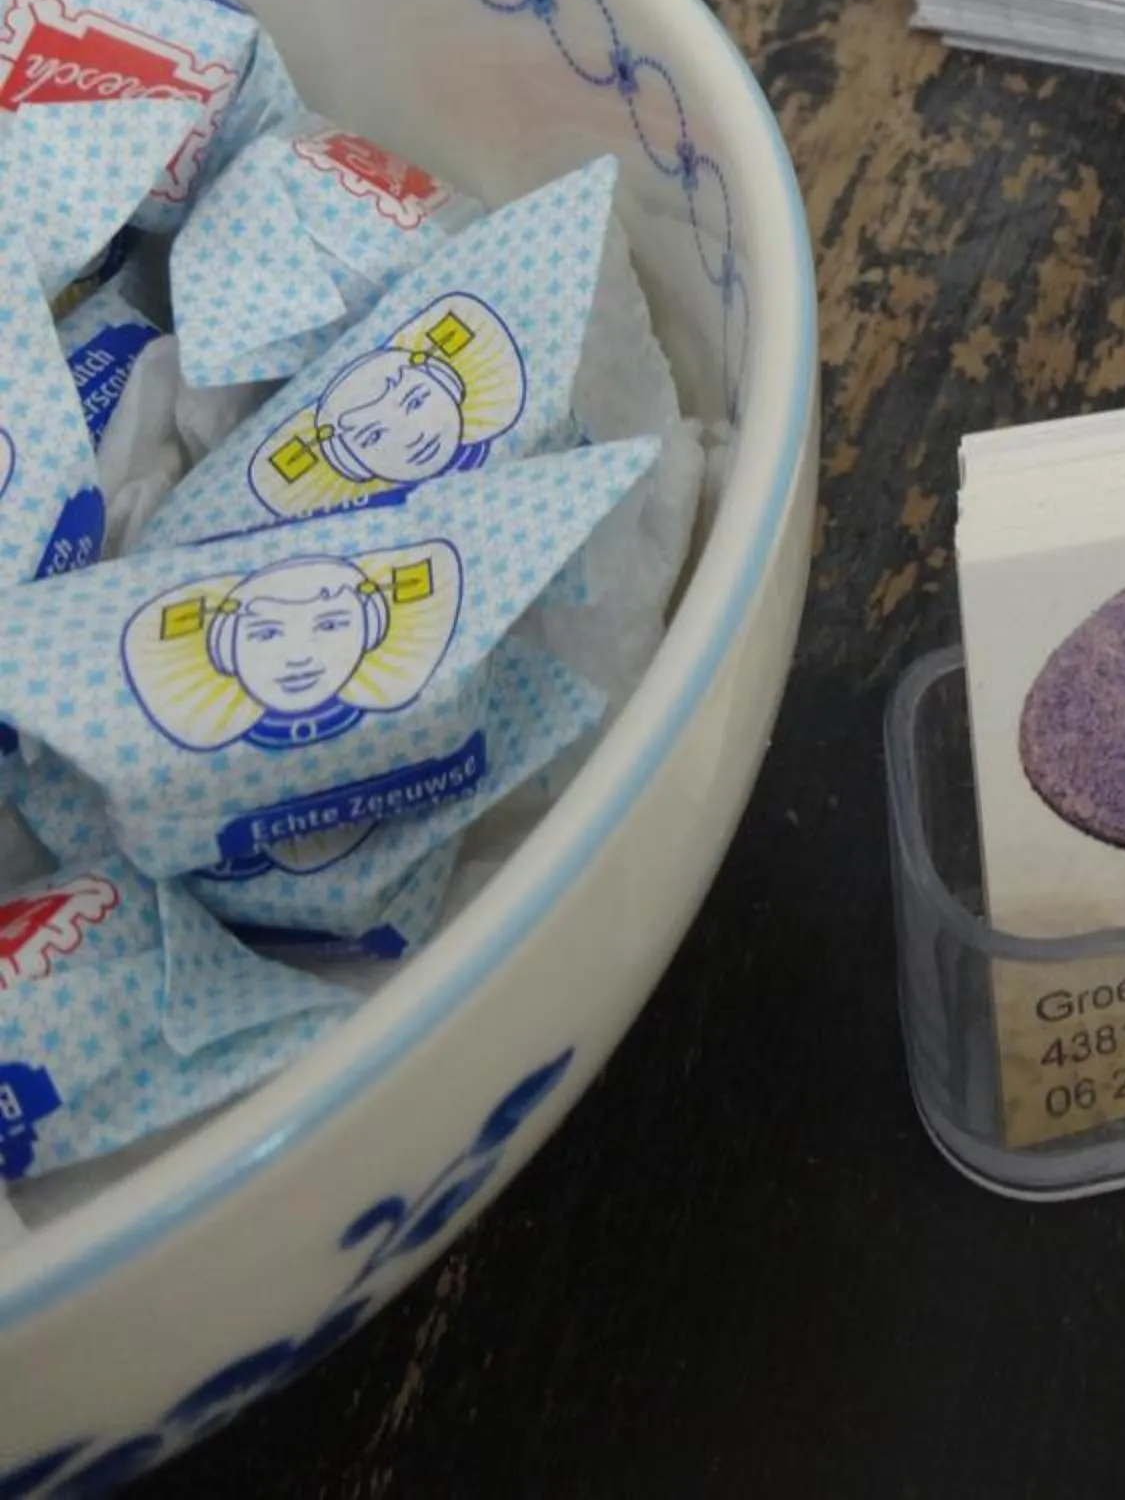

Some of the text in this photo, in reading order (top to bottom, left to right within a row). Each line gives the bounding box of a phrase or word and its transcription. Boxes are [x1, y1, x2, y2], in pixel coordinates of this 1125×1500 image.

[252, 806, 340, 841] Echte
[348, 755, 477, 818] Zeeuwse
[1045, 1076, 1098, 1119] 06
